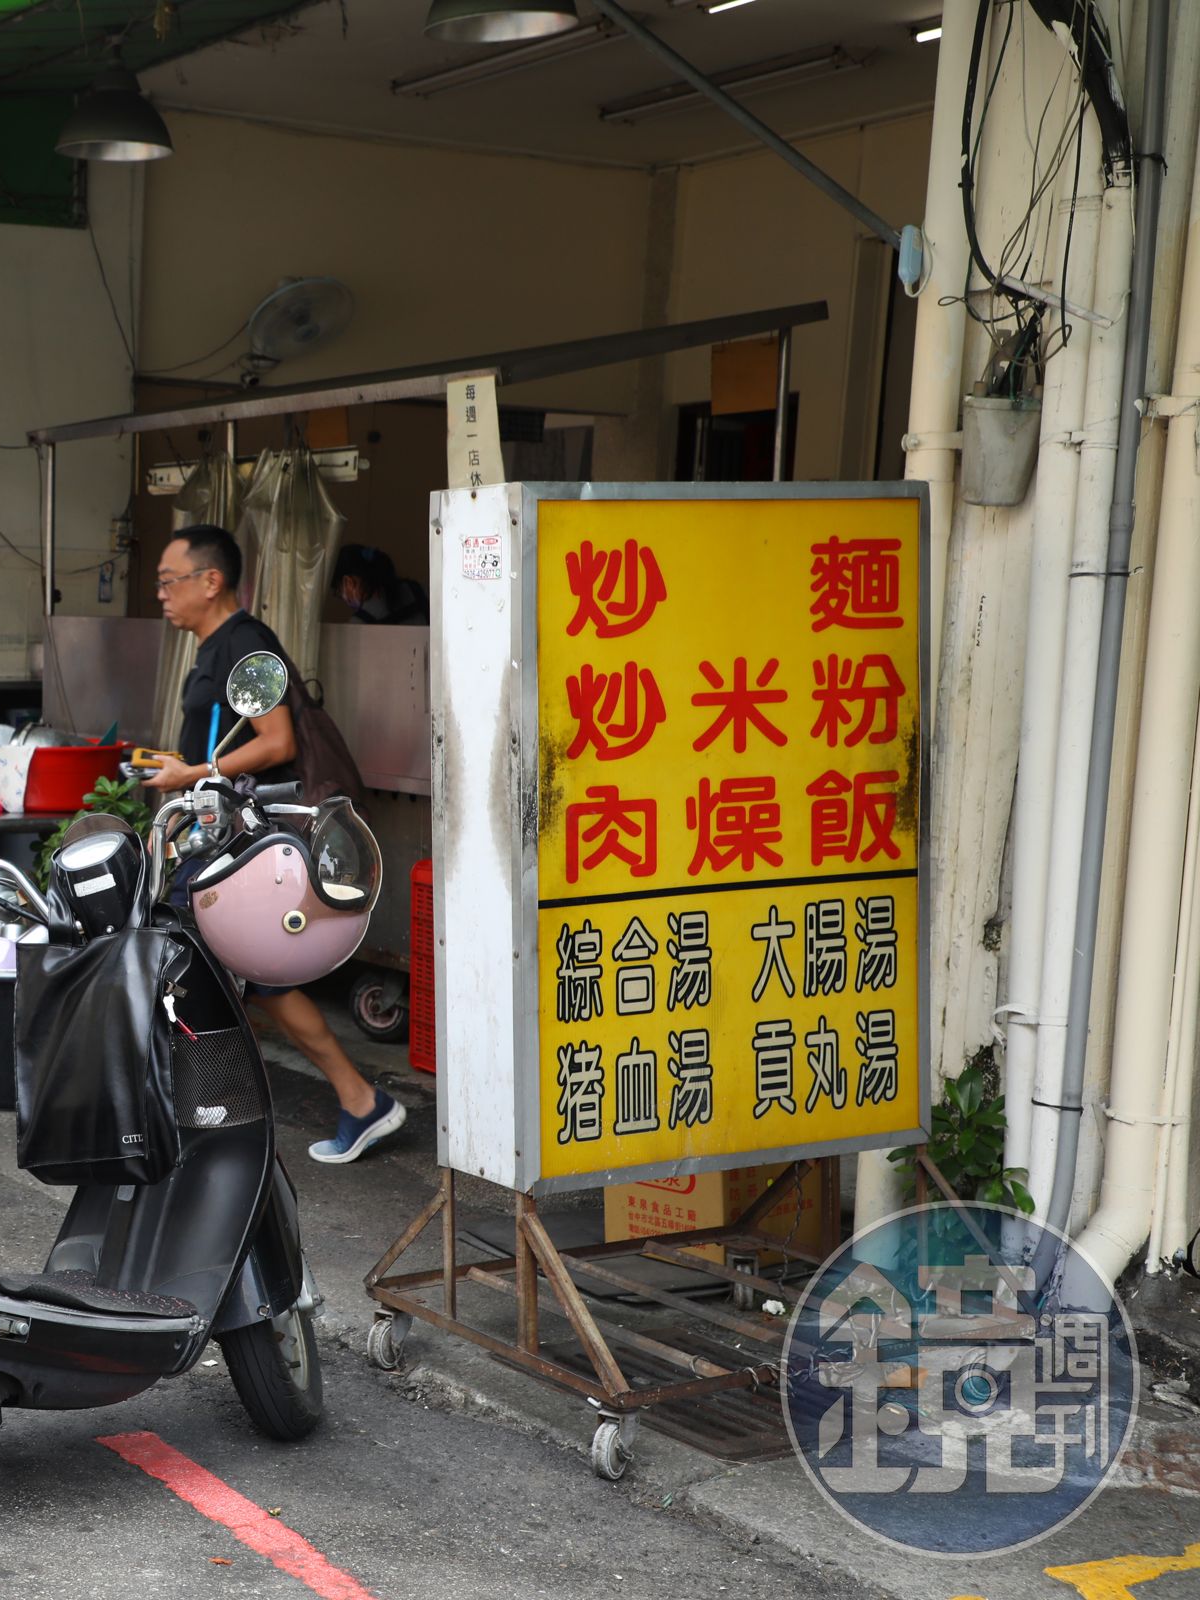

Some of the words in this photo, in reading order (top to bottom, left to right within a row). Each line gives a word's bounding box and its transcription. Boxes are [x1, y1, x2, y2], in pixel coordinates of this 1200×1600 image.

[465, 384, 484, 487] 每週一店休
[566, 653, 906, 761] 炒米粉
[566, 769, 902, 884] 肉燥飯
[556, 911, 712, 1023] 綜合湯
[751, 895, 898, 1003] 大腸湯
[752, 1008, 898, 1120] 貢丸湯
